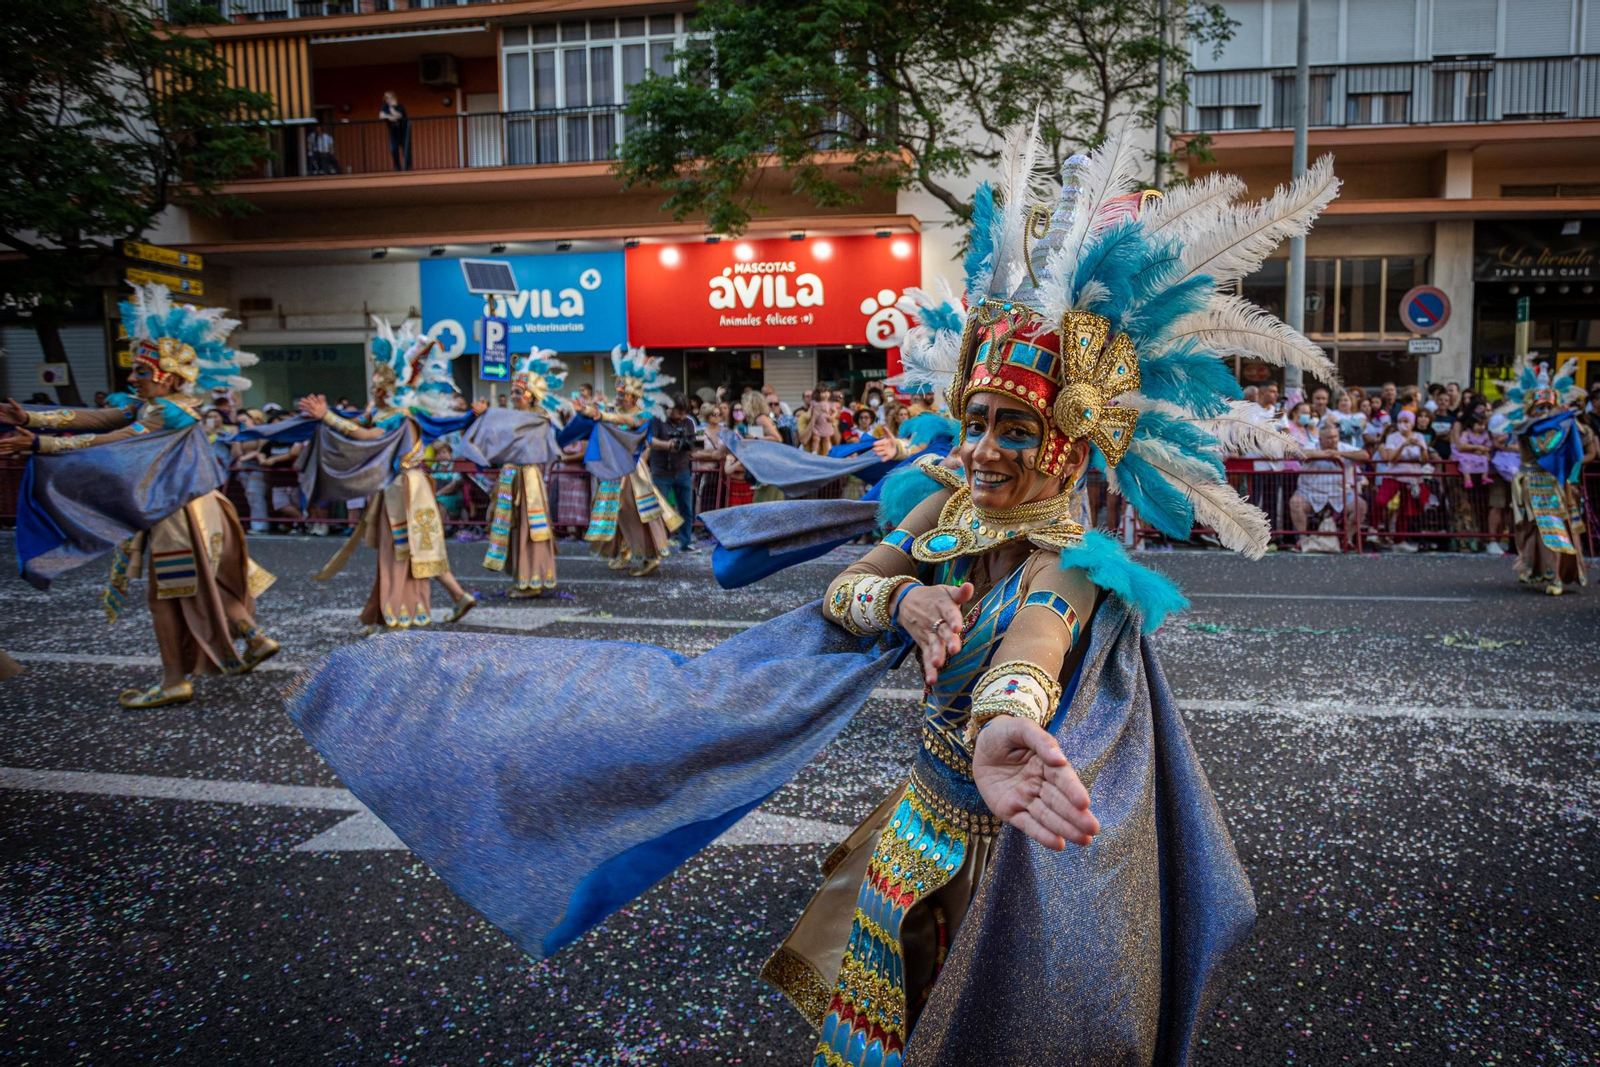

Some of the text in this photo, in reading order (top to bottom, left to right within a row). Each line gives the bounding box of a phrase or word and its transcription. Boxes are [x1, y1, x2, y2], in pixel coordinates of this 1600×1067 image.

[1495, 245, 1594, 267] La tienda
[734, 261, 797, 274] MASCOTAS
[1495, 266, 1590, 277] TAPA BAR CAFÉ
[719, 313, 761, 326] Animales
[765, 312, 798, 325] felices
[525, 322, 585, 333] Veterinarias
[486, 320, 504, 350] P
